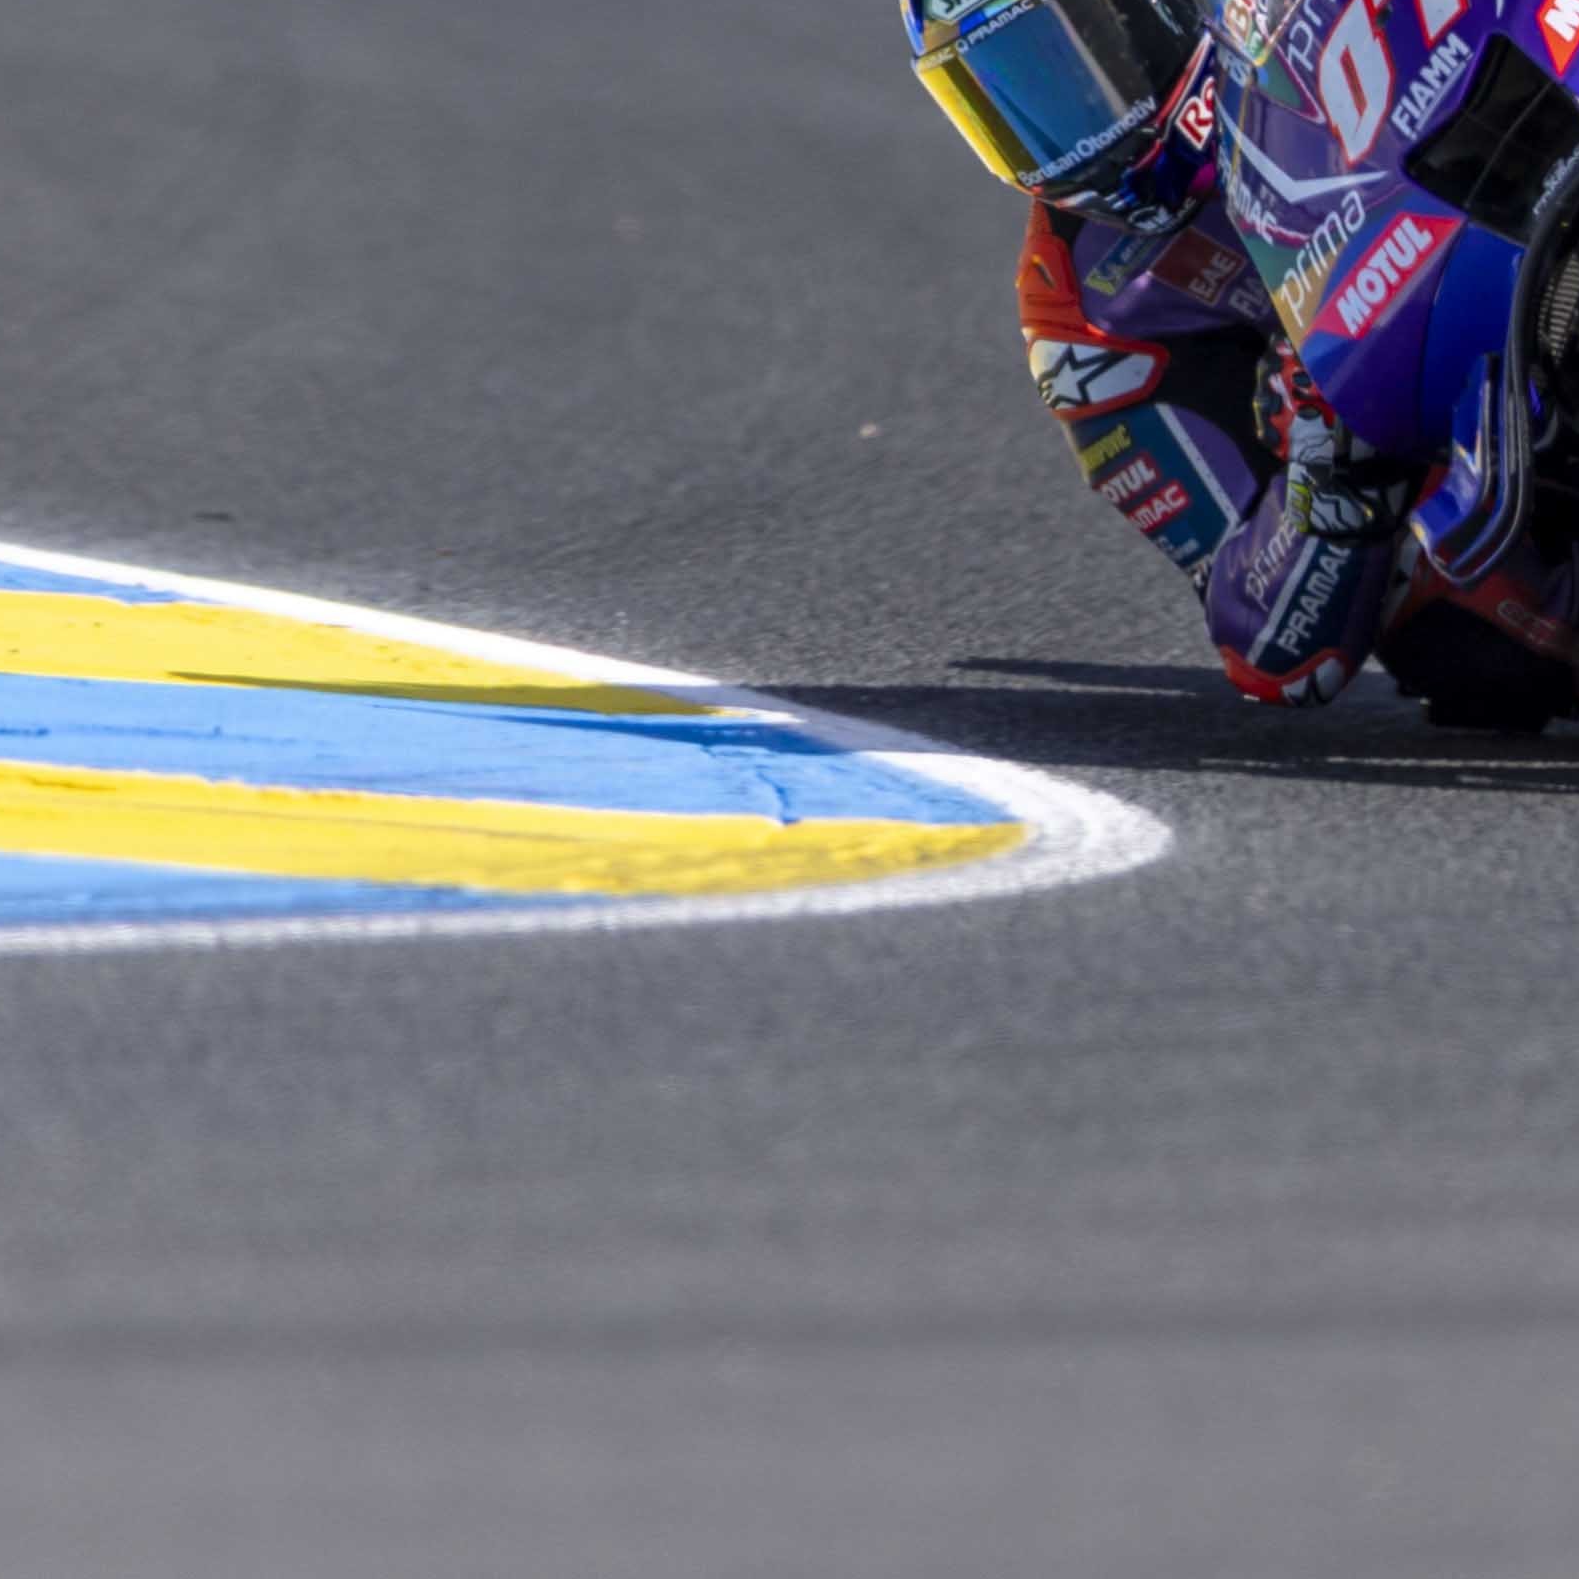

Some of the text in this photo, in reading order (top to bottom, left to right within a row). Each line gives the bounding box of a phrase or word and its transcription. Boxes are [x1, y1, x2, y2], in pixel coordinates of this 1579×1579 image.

[1391, 32, 1472, 141] FIAMM
[1280, 189, 1366, 329] prima
[1336, 217, 1433, 335] MOTUL
[1100, 458, 1157, 502] OTUL
